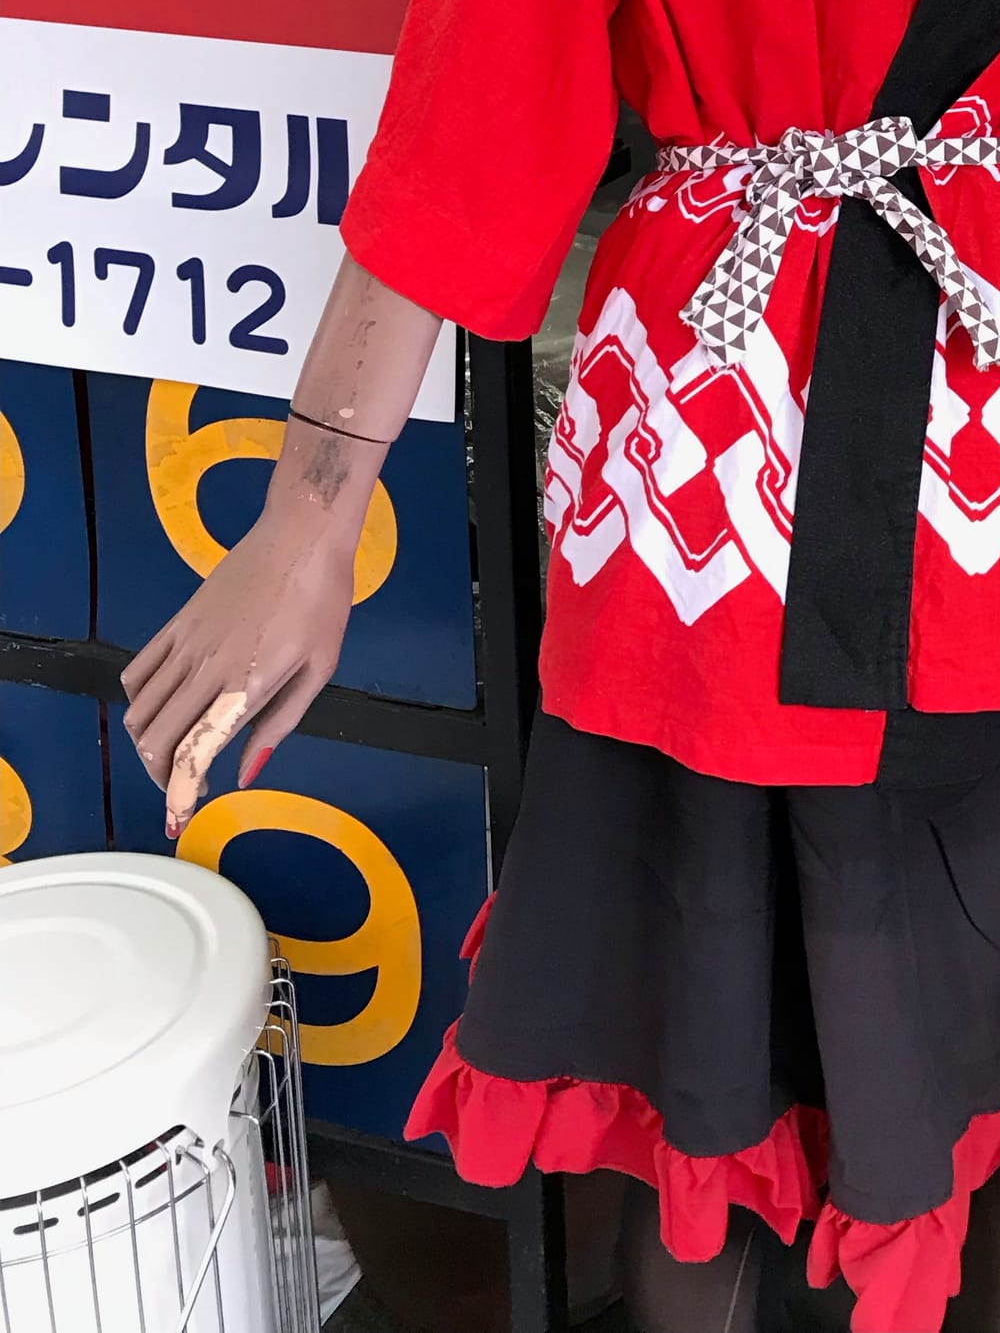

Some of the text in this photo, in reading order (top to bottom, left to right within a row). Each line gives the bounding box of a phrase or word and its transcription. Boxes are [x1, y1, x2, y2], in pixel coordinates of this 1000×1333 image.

[0, 241, 289, 355] -1712
[146, 378, 398, 605] 6
[176, 788, 422, 1067] 9
